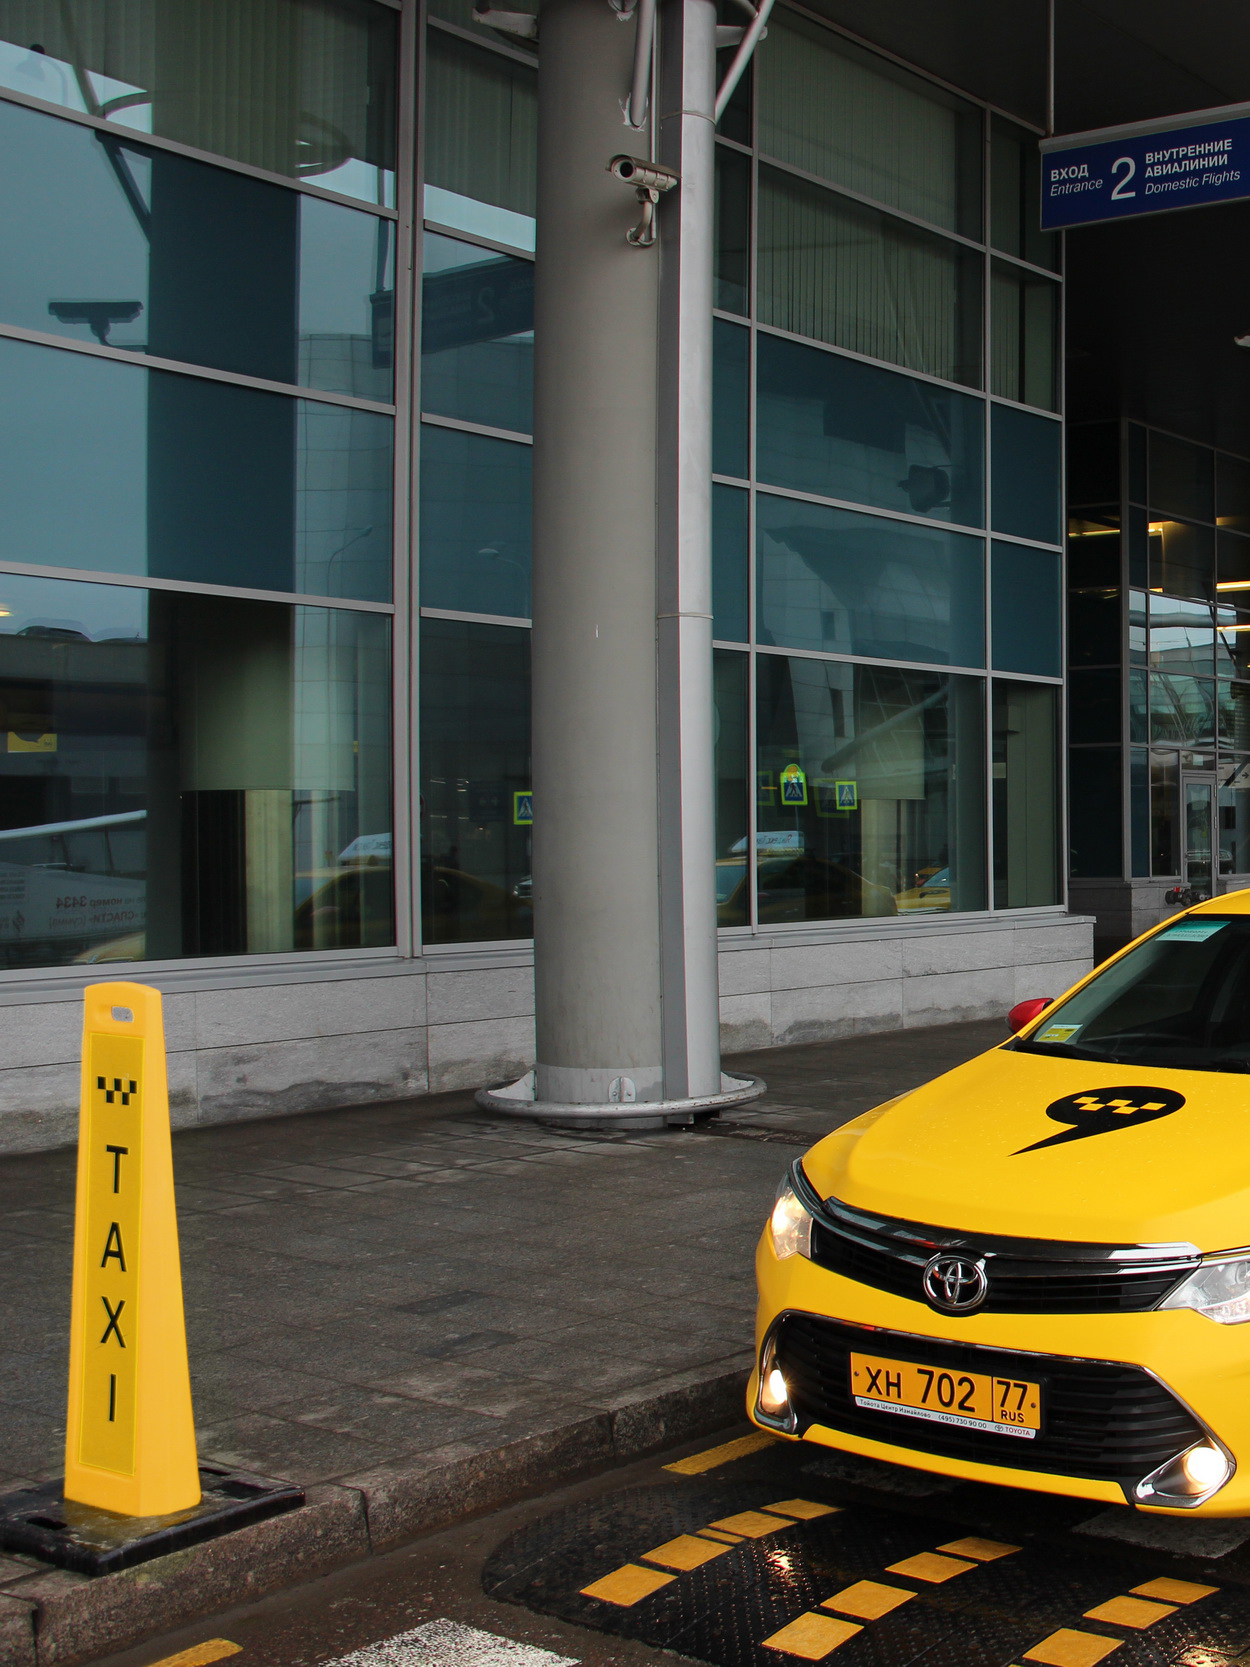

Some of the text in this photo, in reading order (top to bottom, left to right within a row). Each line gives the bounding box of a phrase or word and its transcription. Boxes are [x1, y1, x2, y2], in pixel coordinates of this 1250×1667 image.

[1145, 139, 1233, 164] ВНУТРЕННИЕ
[1050, 164, 1089, 182] ВХОД
[1111, 157, 1136, 200] 2
[1144, 154, 1228, 178] АВИАЛИНИИ
[1050, 178, 1103, 197] Entrance
[1145, 169, 1241, 195] Domestic Flights
[100, 1144, 128, 1422] TAXI
[917, 1368, 976, 1413] 702
[996, 1380, 1028, 1411] 77
[860, 1399, 880, 1408] Тойота
[881, 1402, 898, 1412] Центр
[899, 1405, 931, 1418] Измайлово
[938, 1414, 955, 1423] (495)
[956, 1417, 967, 1425] 730
[1005, 1426, 1031, 1436] TOYOTA
[1000, 1409, 1025, 1423] RUS
